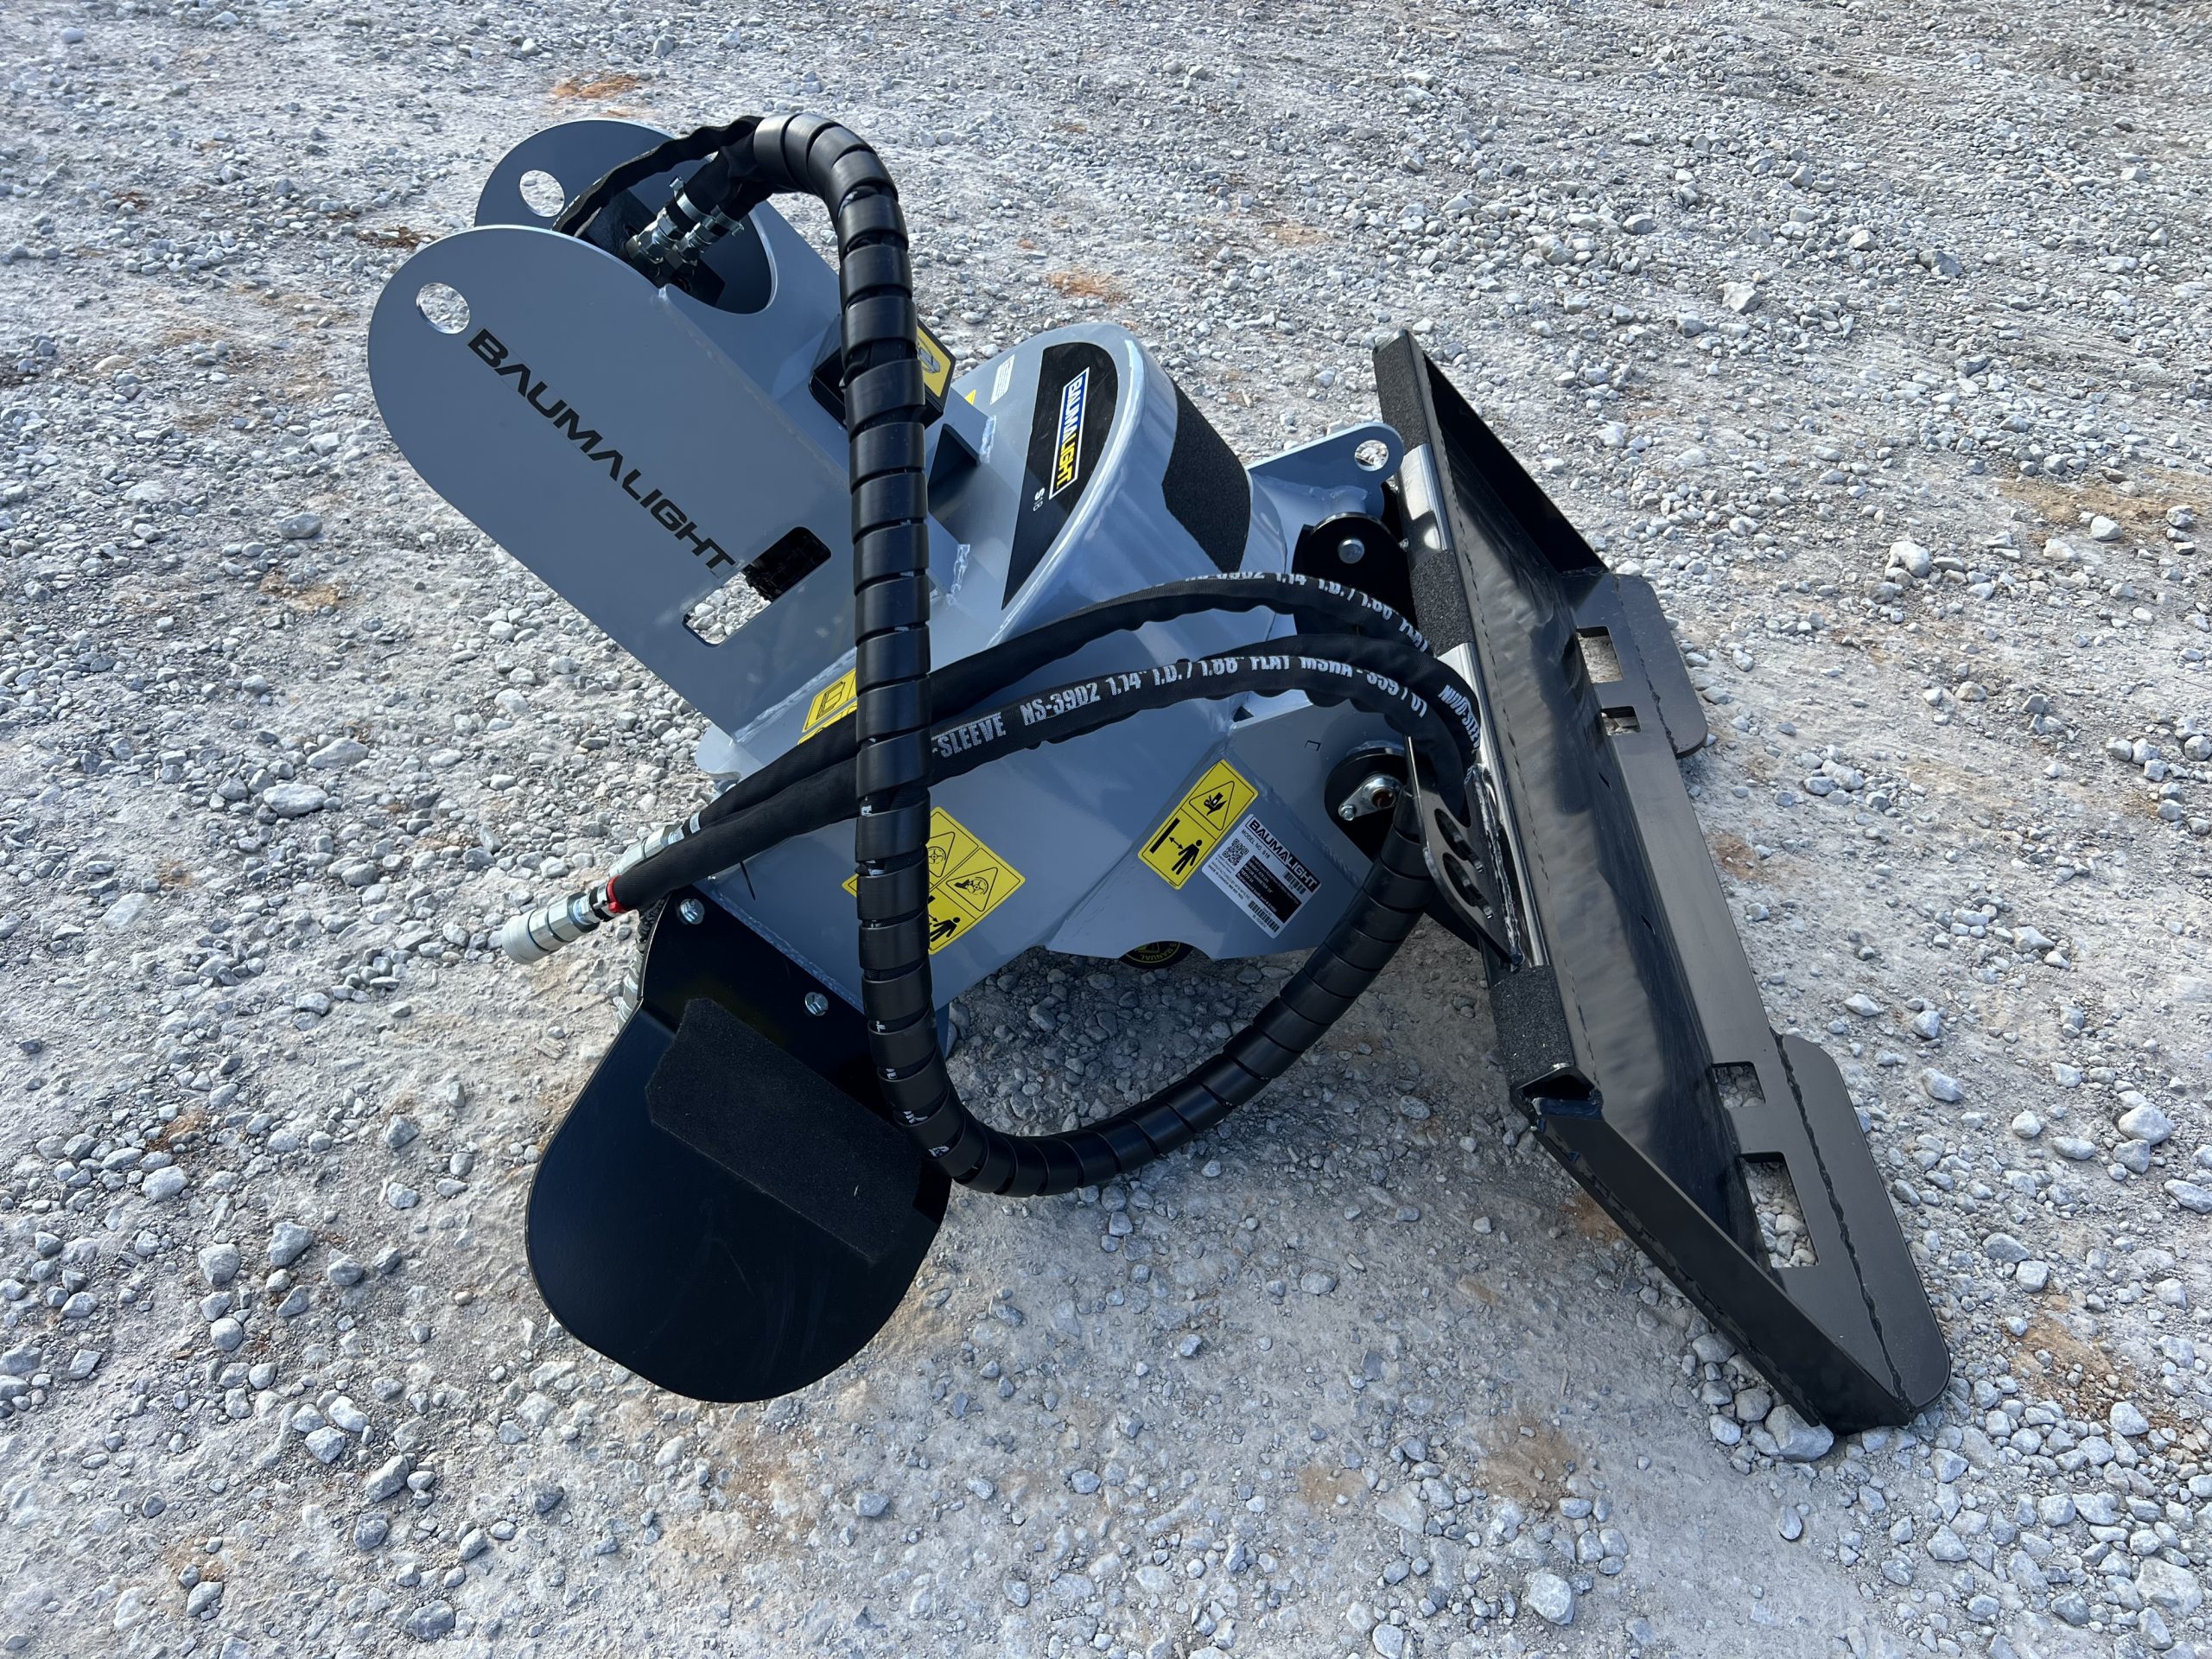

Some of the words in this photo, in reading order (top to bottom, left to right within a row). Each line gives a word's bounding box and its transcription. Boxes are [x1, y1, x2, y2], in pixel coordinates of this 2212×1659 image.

[467, 328, 735, 574] BAUMALIGHT
[1057, 376, 1084, 488] BAUMALIGHT
[1033, 487, 1045, 512] S18
[1020, 683, 1101, 726] NS-3902
[1186, 661, 1193, 679] /
[1250, 655, 1290, 671] FLAT
[1240, 829, 1255, 844] MODEL
[1248, 818, 1317, 889] BAUMALIGHT
